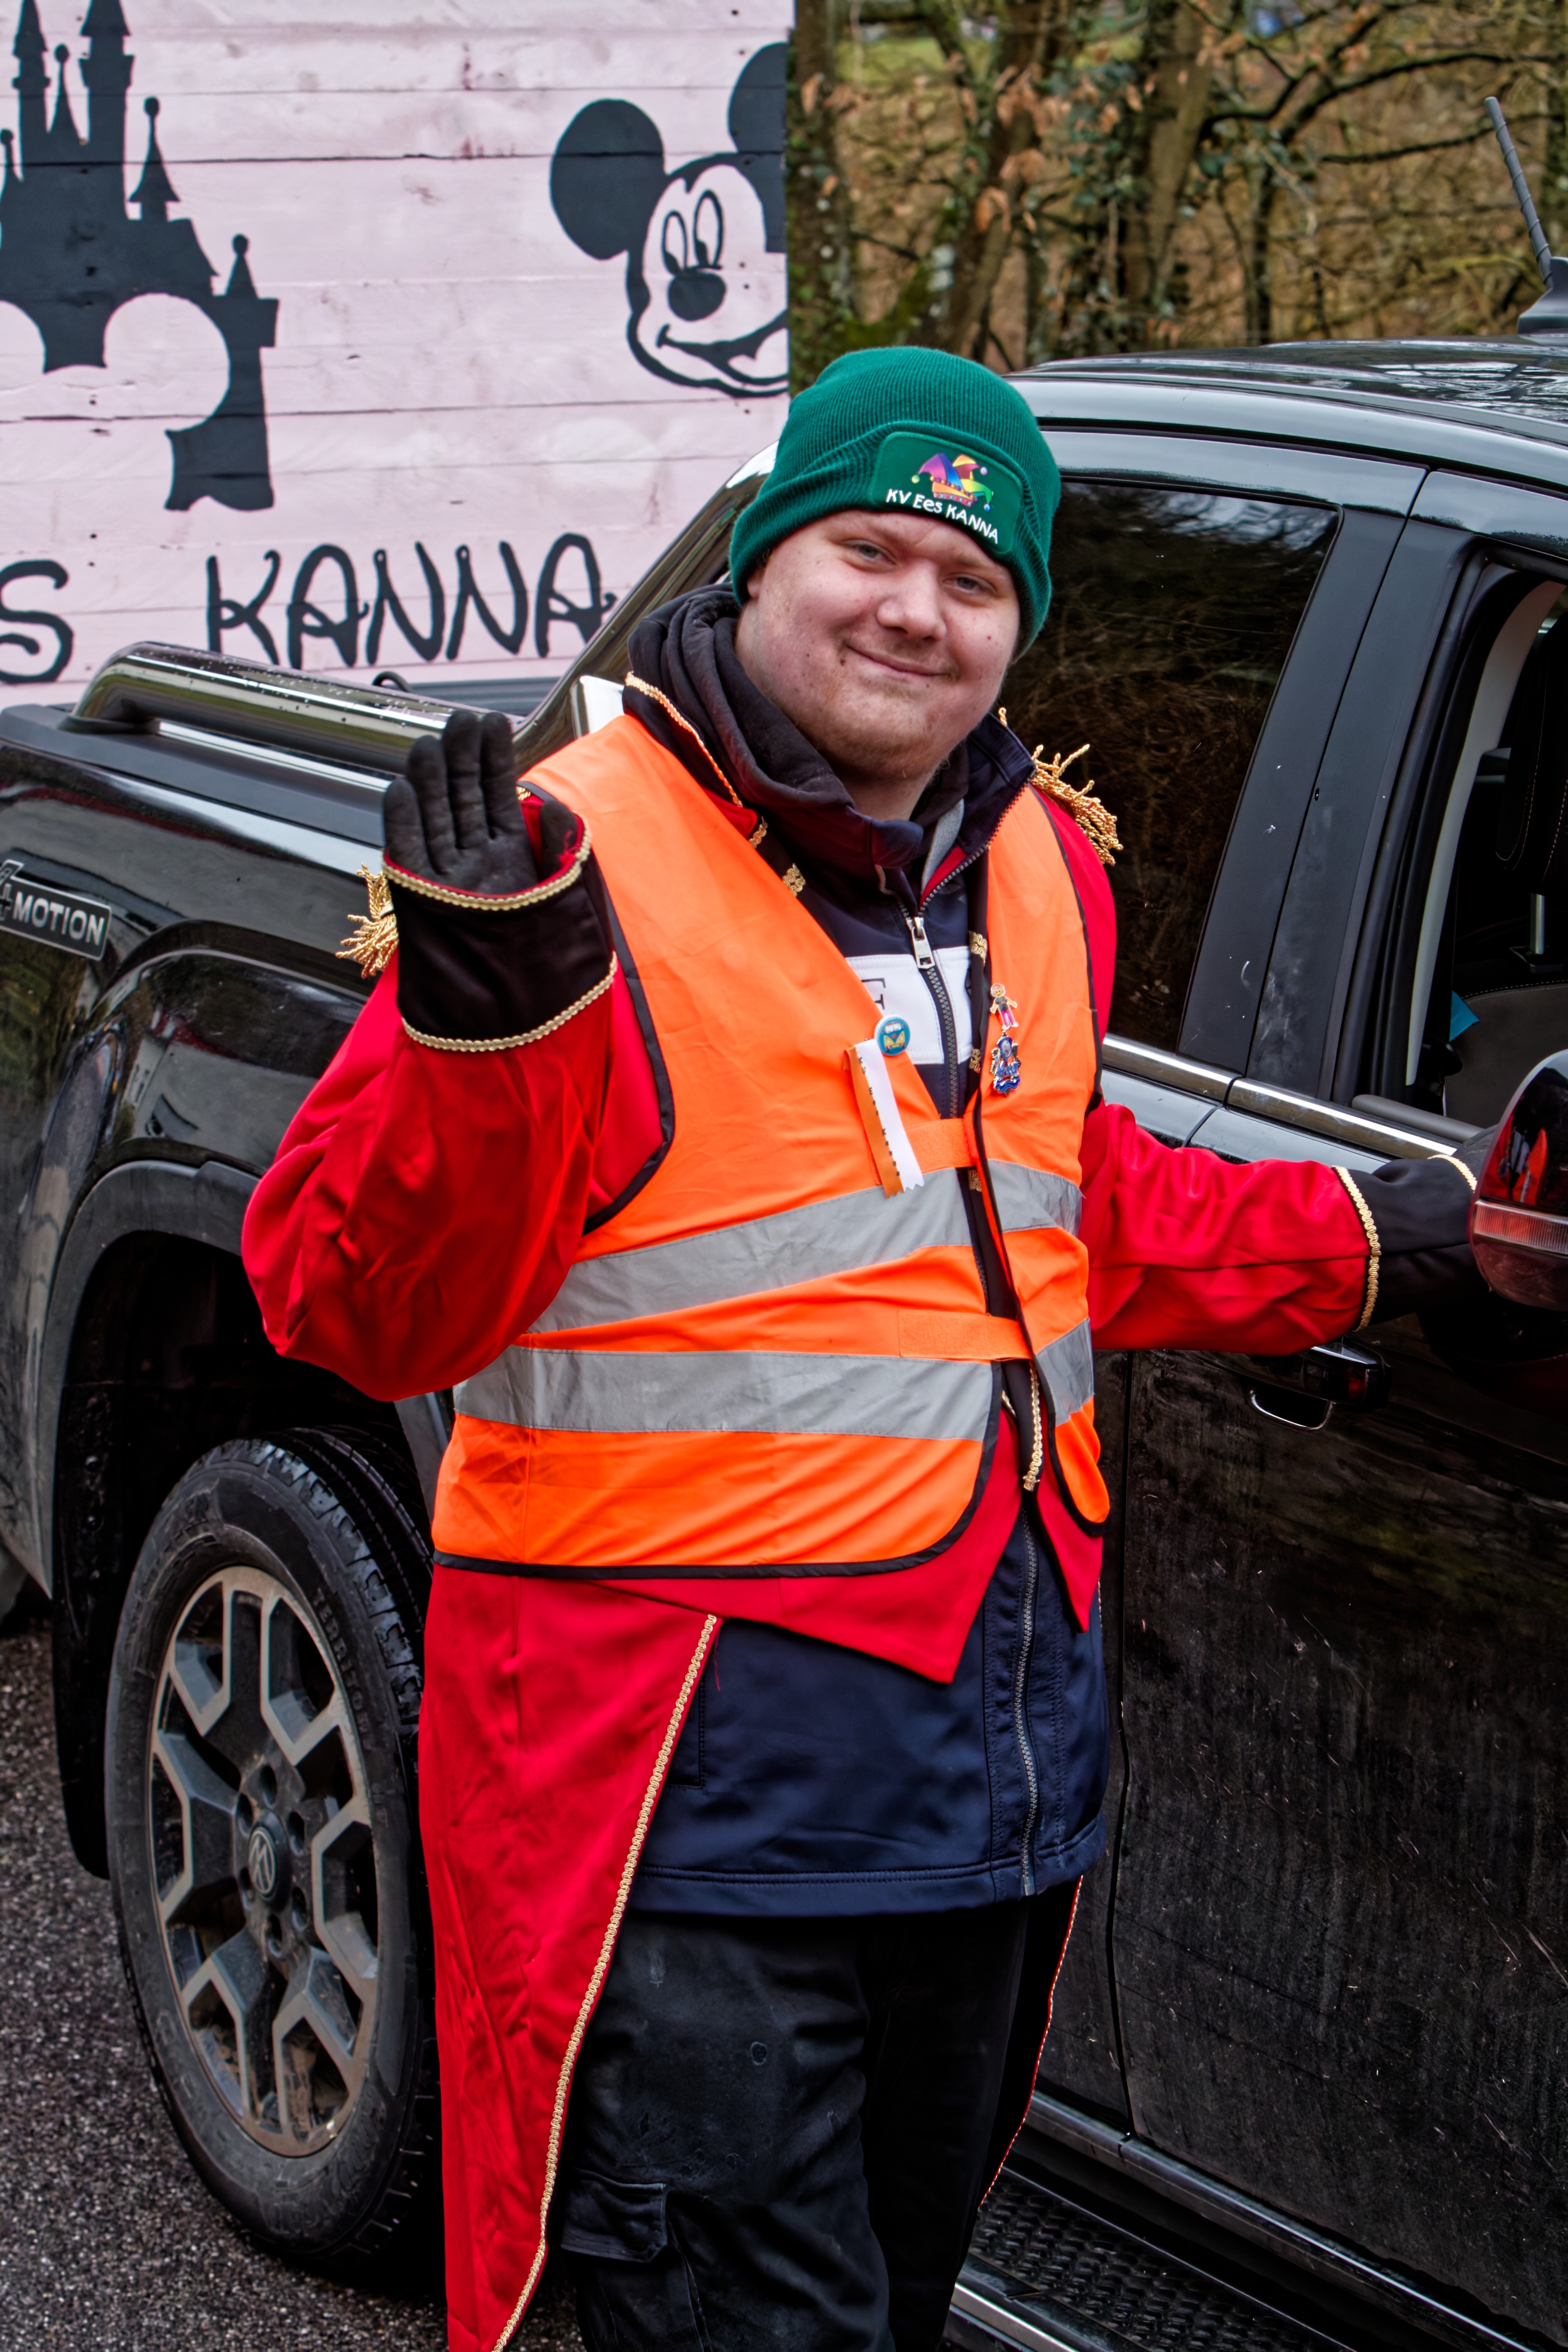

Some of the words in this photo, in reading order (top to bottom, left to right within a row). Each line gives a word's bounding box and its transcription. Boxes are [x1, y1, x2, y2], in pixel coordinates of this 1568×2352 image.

[886, 489, 912, 504] KV
[913, 494, 942, 513] Ees
[945, 504, 998, 544] KANNA
[206, 533, 616, 670] KANNA
[312, 1587, 377, 1751] TERRITORY
